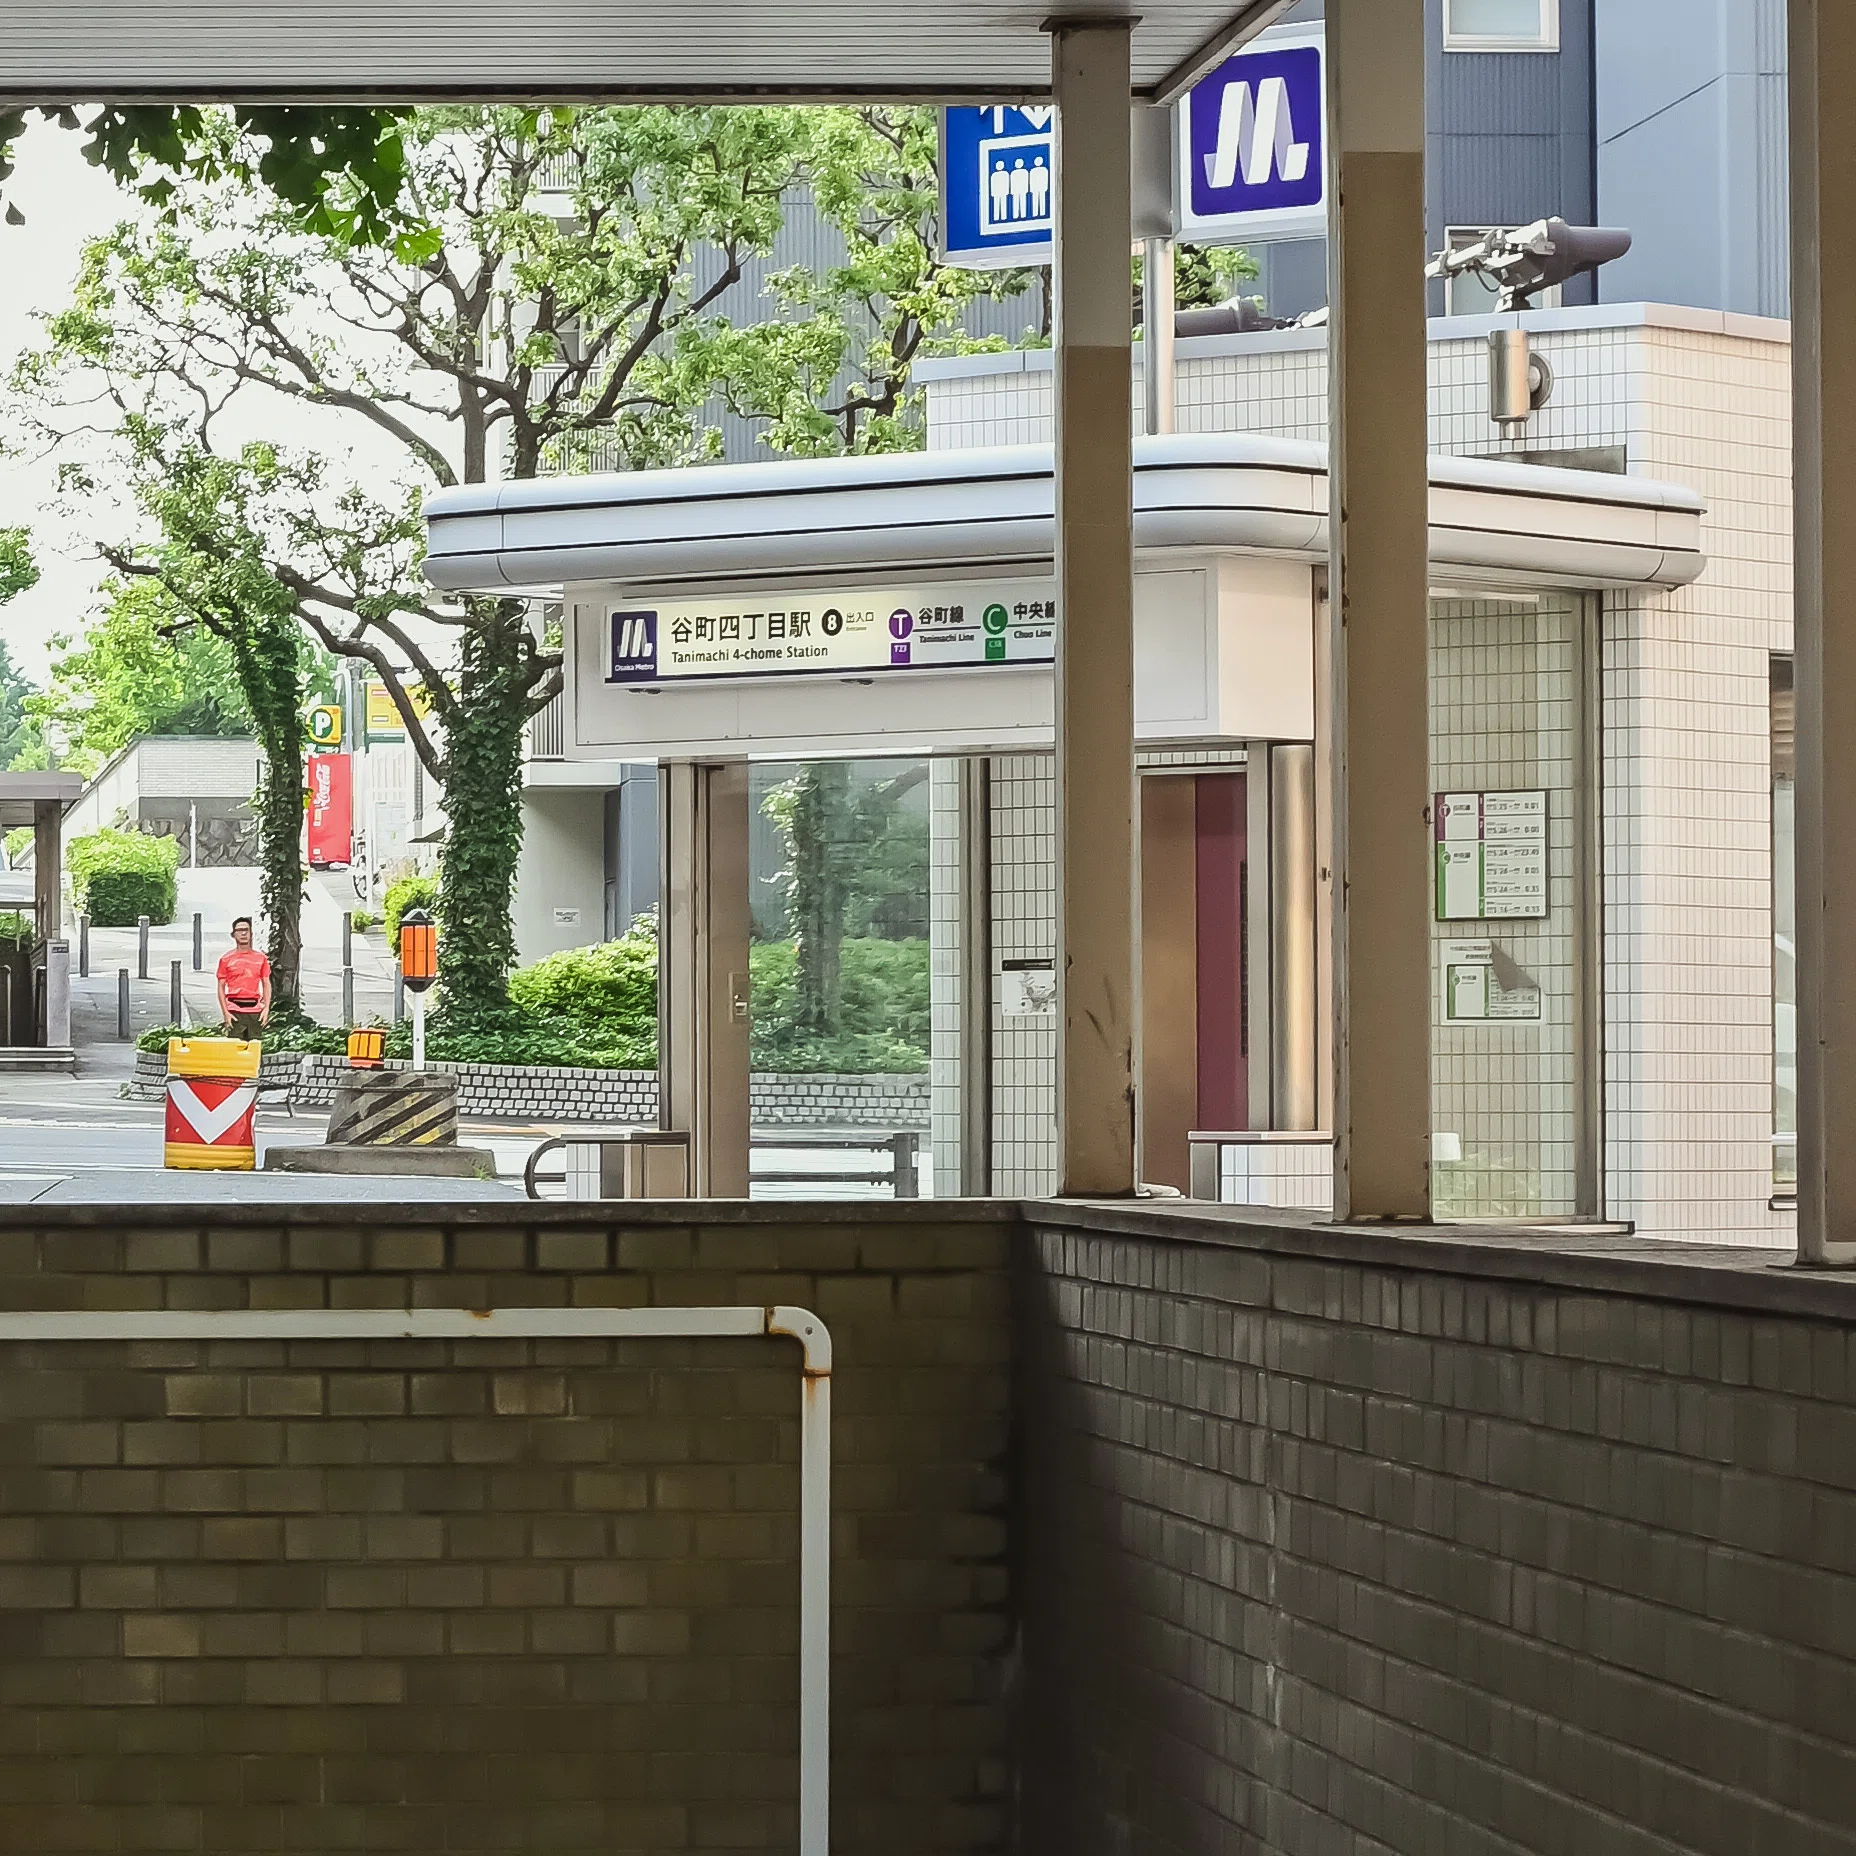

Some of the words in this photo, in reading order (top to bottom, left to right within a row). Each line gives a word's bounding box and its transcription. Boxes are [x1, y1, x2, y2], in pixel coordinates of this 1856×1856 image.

[918, 605, 964, 625] 谷町線
[671, 611, 812, 644] 谷町四丁目駅
[846, 611, 874, 624] 出入口
[671, 648, 730, 664] Tanimachi
[732, 647, 783, 662] 4-chome
[786, 644, 829, 659] Station
